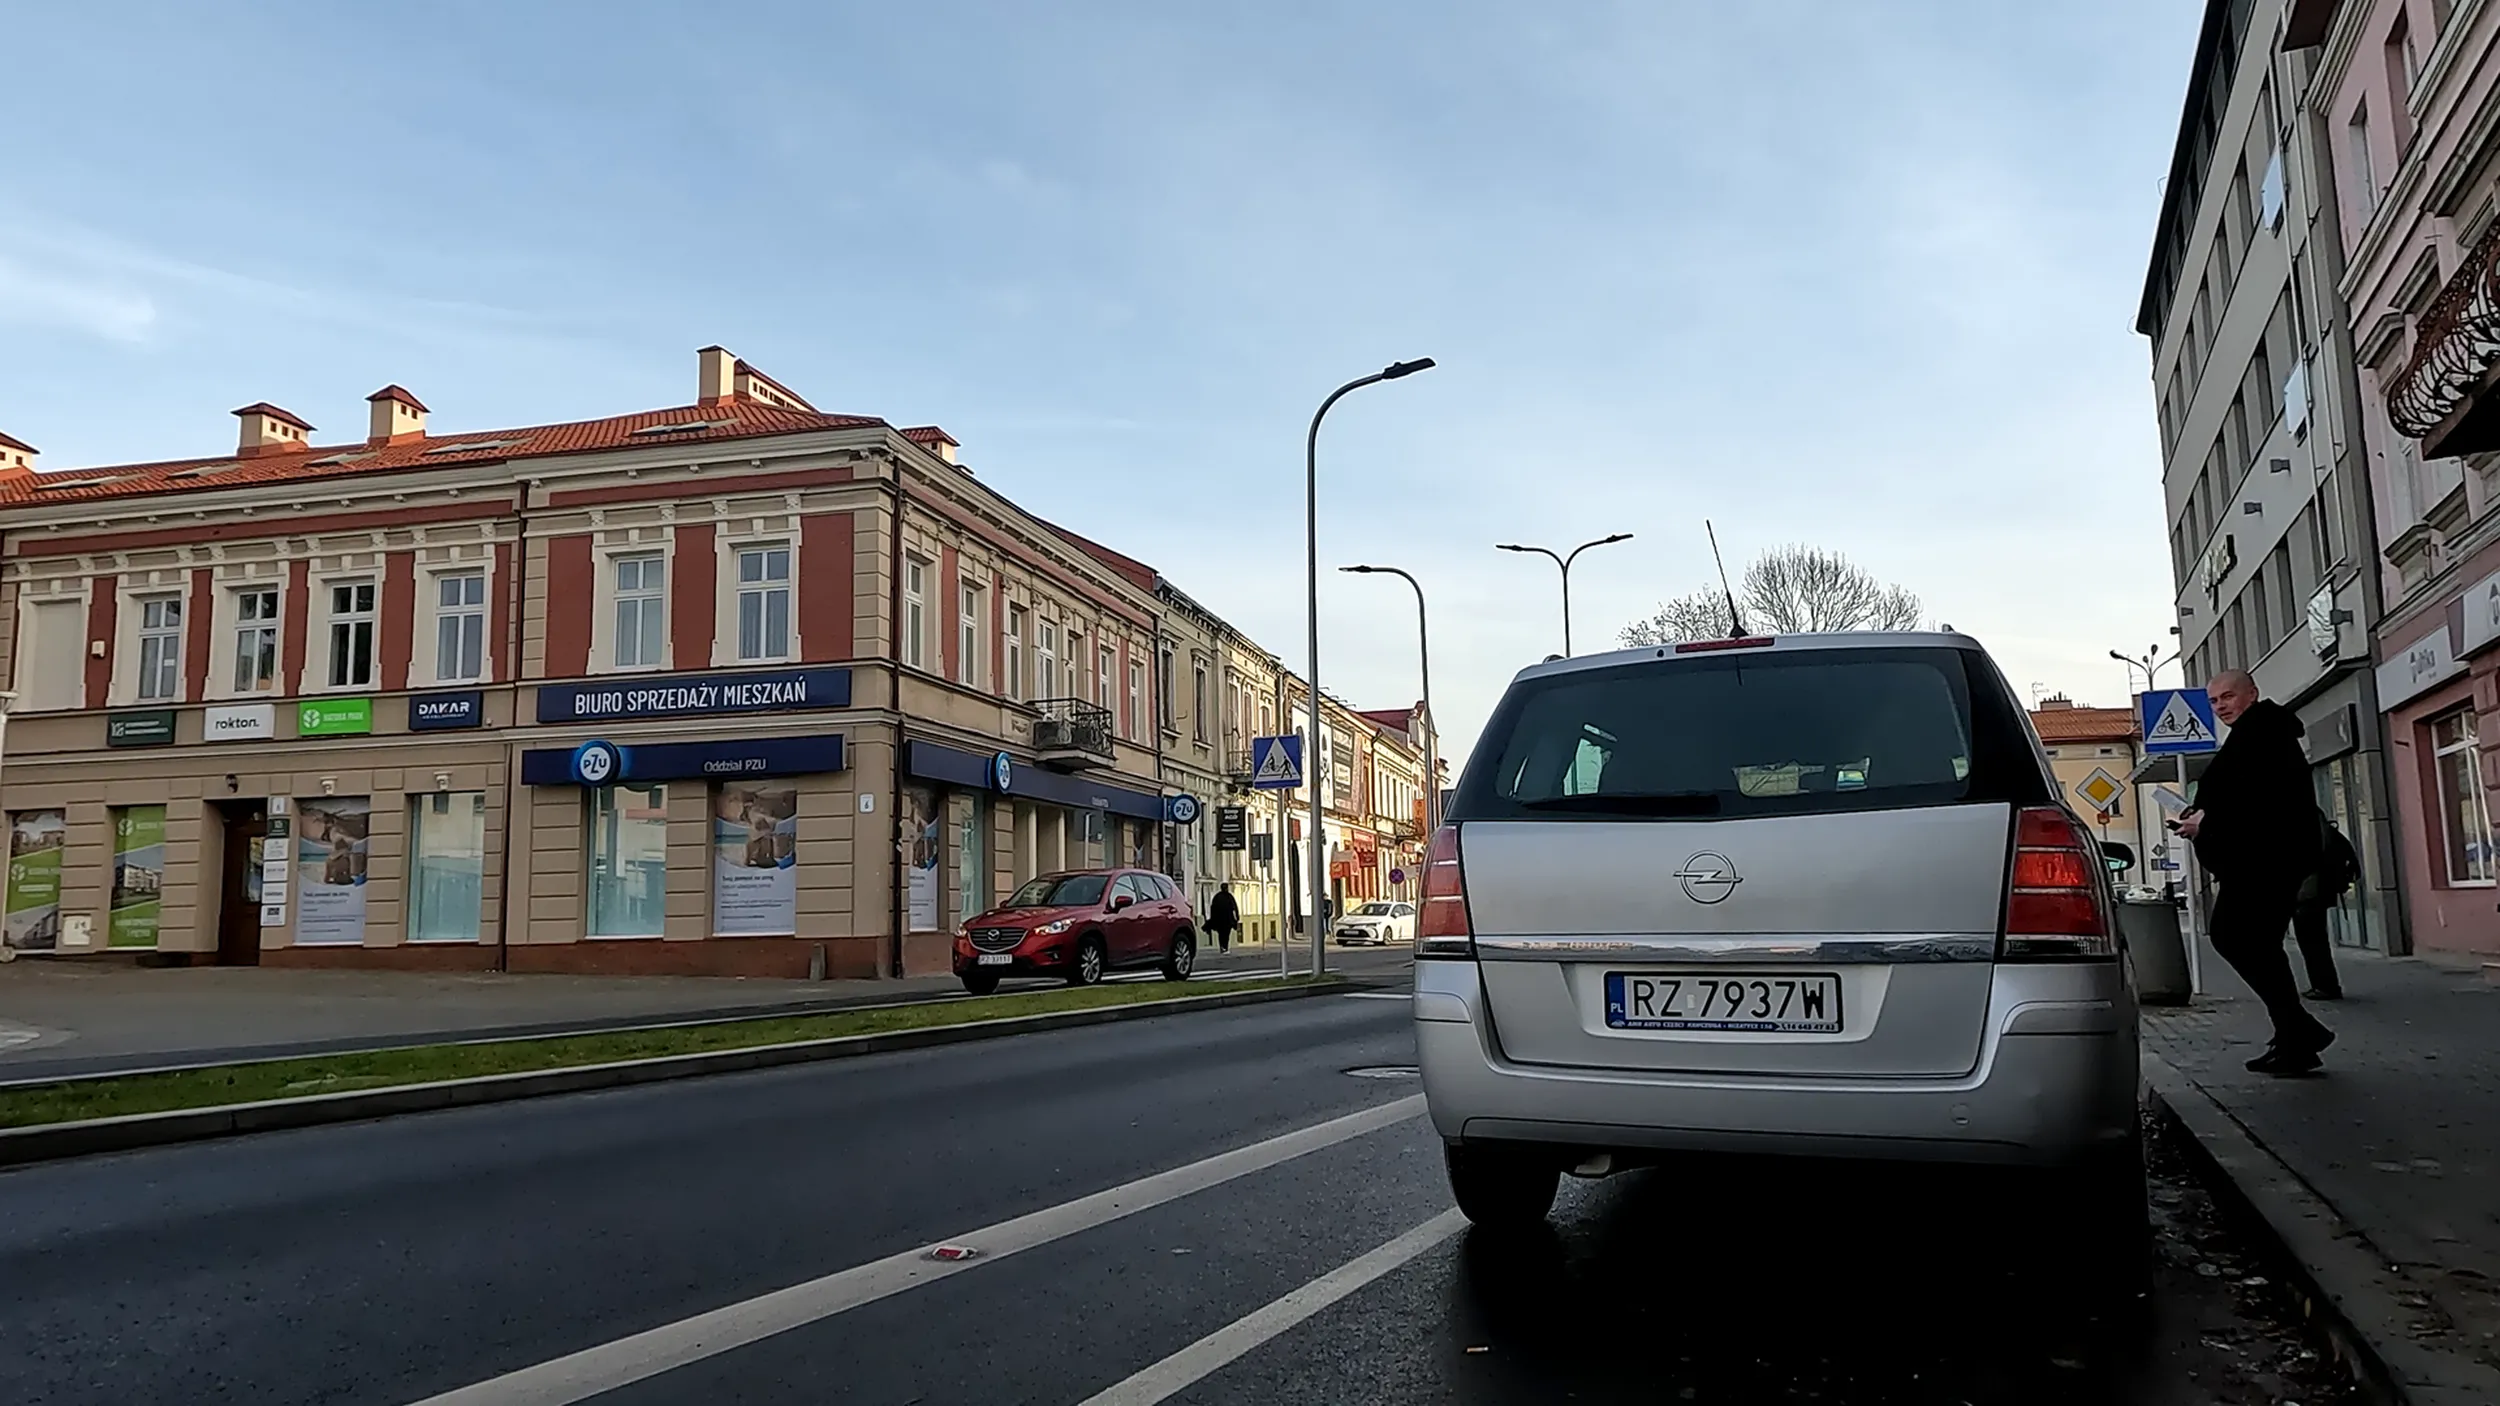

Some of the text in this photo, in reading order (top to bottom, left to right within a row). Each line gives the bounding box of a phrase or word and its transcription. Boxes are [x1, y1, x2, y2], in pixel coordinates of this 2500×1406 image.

[575, 676, 807, 715] BIURO SPRZEDAŻY MIESZKAŃ
[418, 701, 470, 715] DAKAR
[214, 717, 260, 730] rokton.
[583, 753, 608, 774] PZU
[703, 758, 767, 773] Oddział PZU
[863, 799, 870, 810] 6
[1175, 802, 1193, 817] PZU
[1632, 980, 1824, 1019] RZ 7937W
[1610, 1003, 1624, 1013] PL
